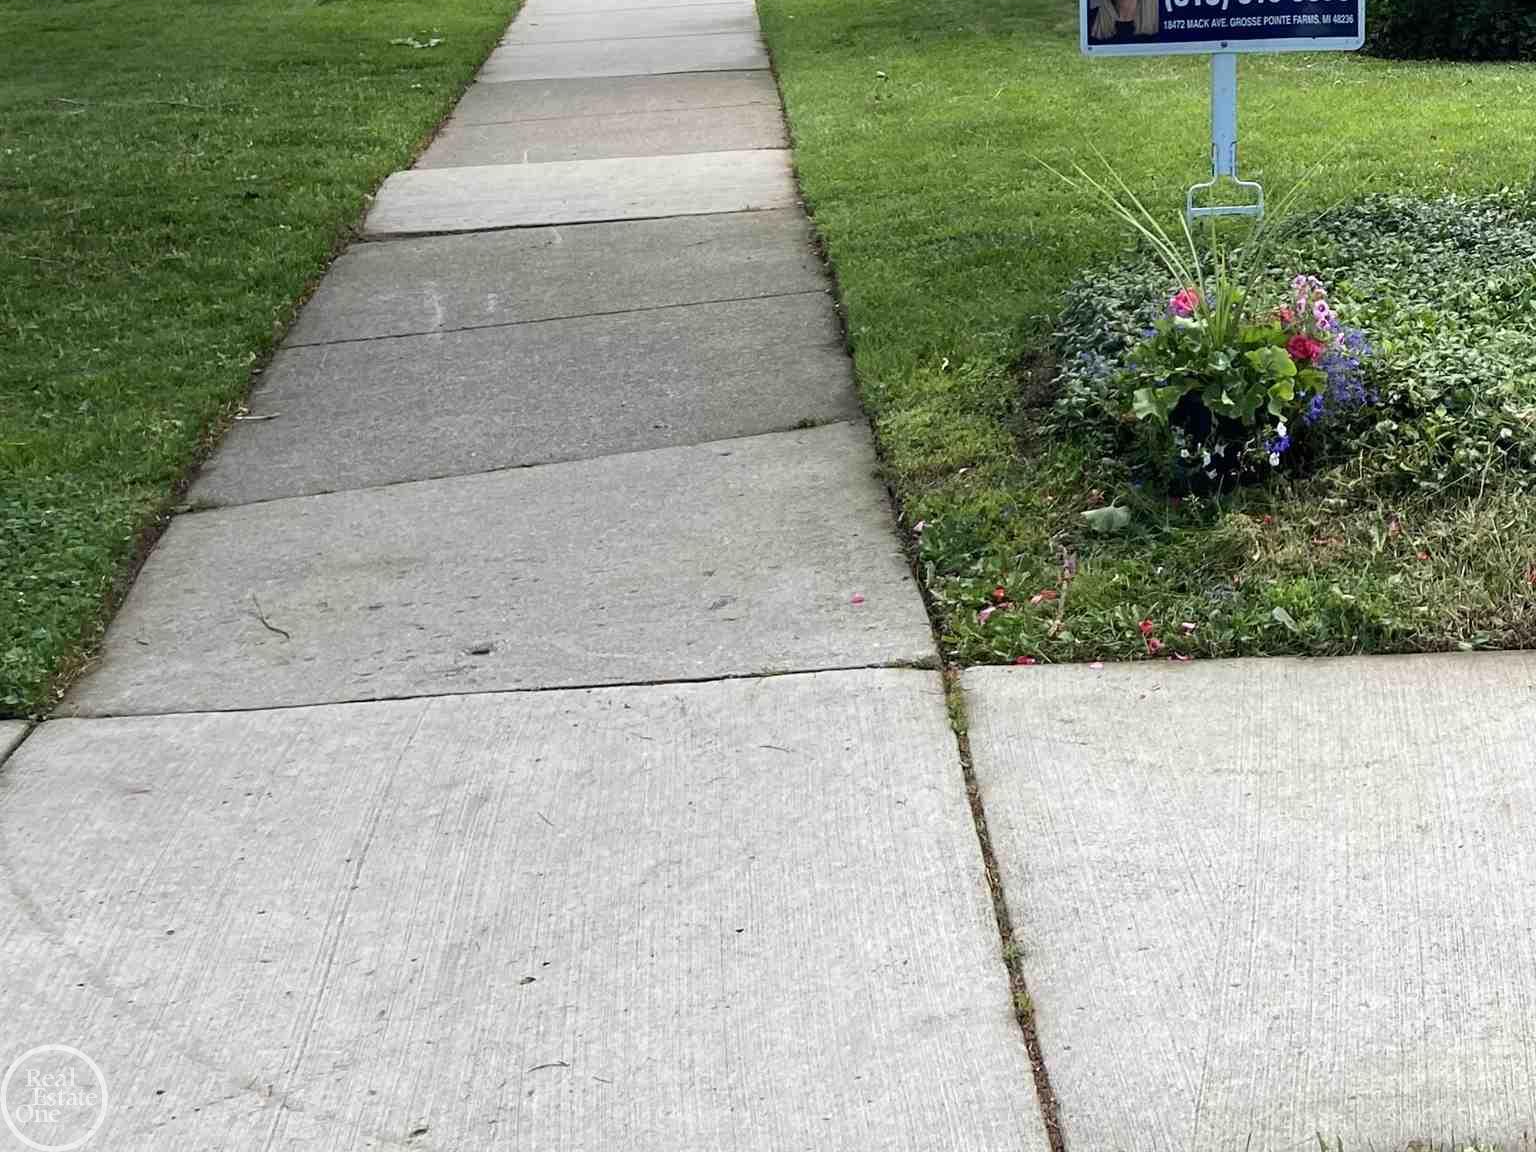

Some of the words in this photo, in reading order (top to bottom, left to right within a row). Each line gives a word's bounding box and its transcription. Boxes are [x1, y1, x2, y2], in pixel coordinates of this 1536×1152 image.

[1187, 18, 1210, 29] MACK
[1230, 16, 1262, 27] GROSSE
[1263, 15, 1292, 26] POINTE
[1322, 14, 1332, 24] MI
